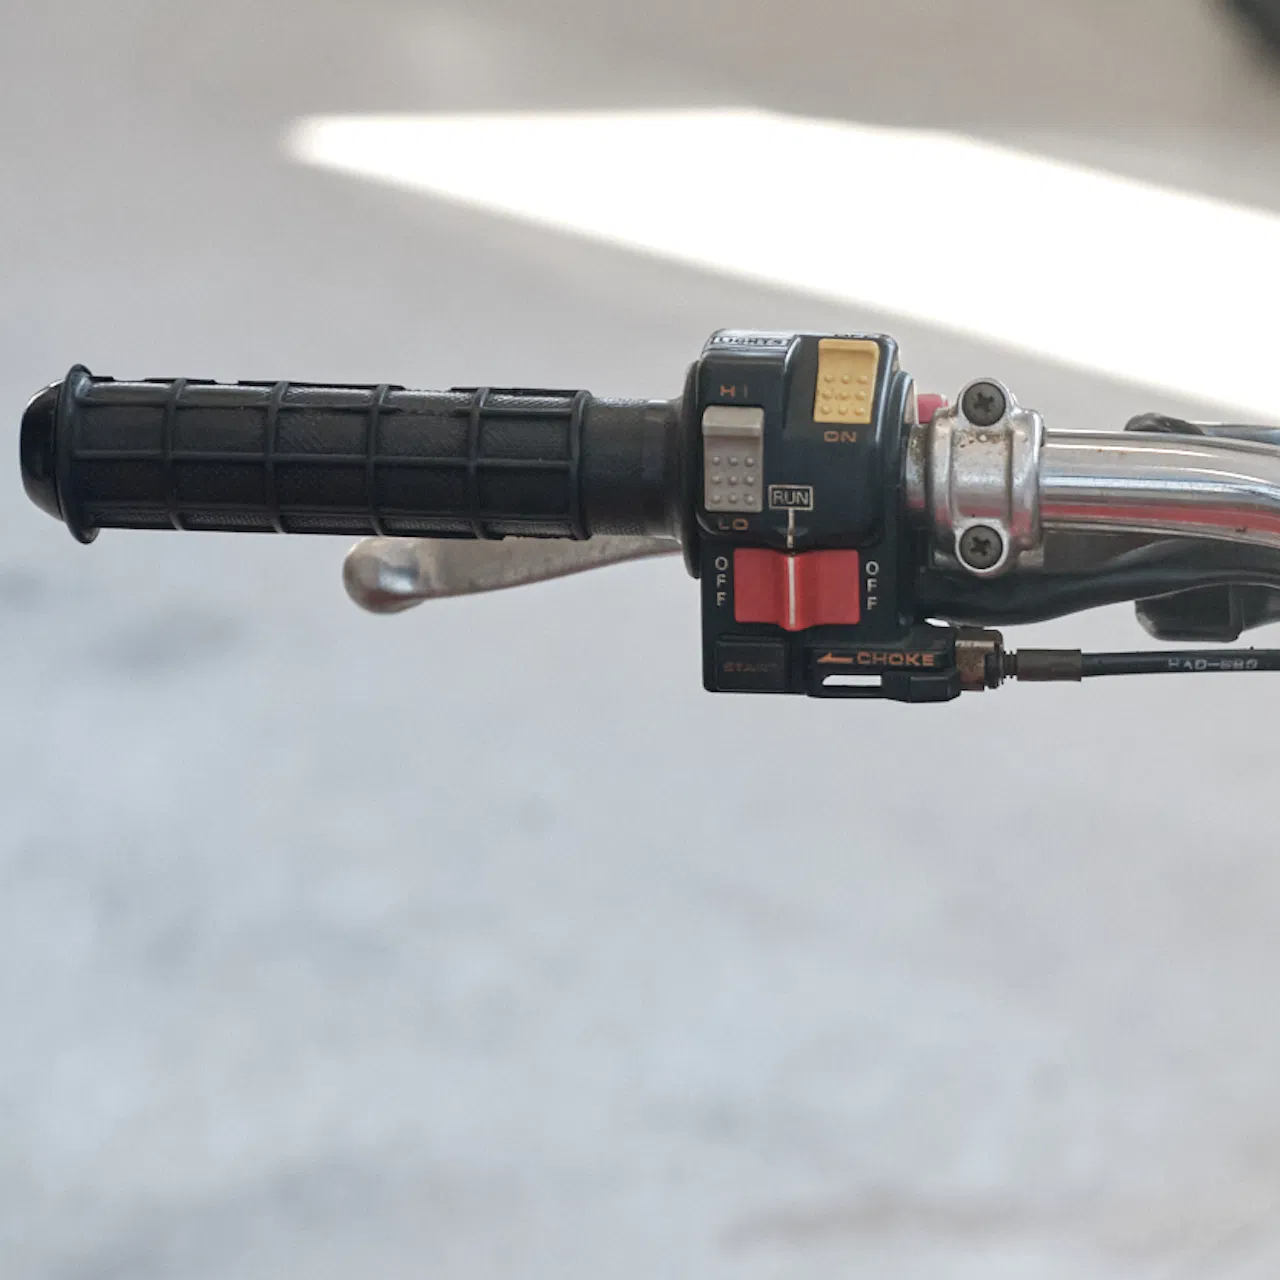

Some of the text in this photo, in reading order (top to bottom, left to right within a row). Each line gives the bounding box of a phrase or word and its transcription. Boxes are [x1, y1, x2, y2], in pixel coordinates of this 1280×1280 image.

[720, 385, 748, 397] HI
[824, 431, 857, 442] ON
[773, 491, 810, 505] RUN
[718, 518, 749, 531] LO
[715, 556, 729, 606] OFF
[866, 561, 880, 611] OFF
[857, 652, 936, 667] CHOKE
